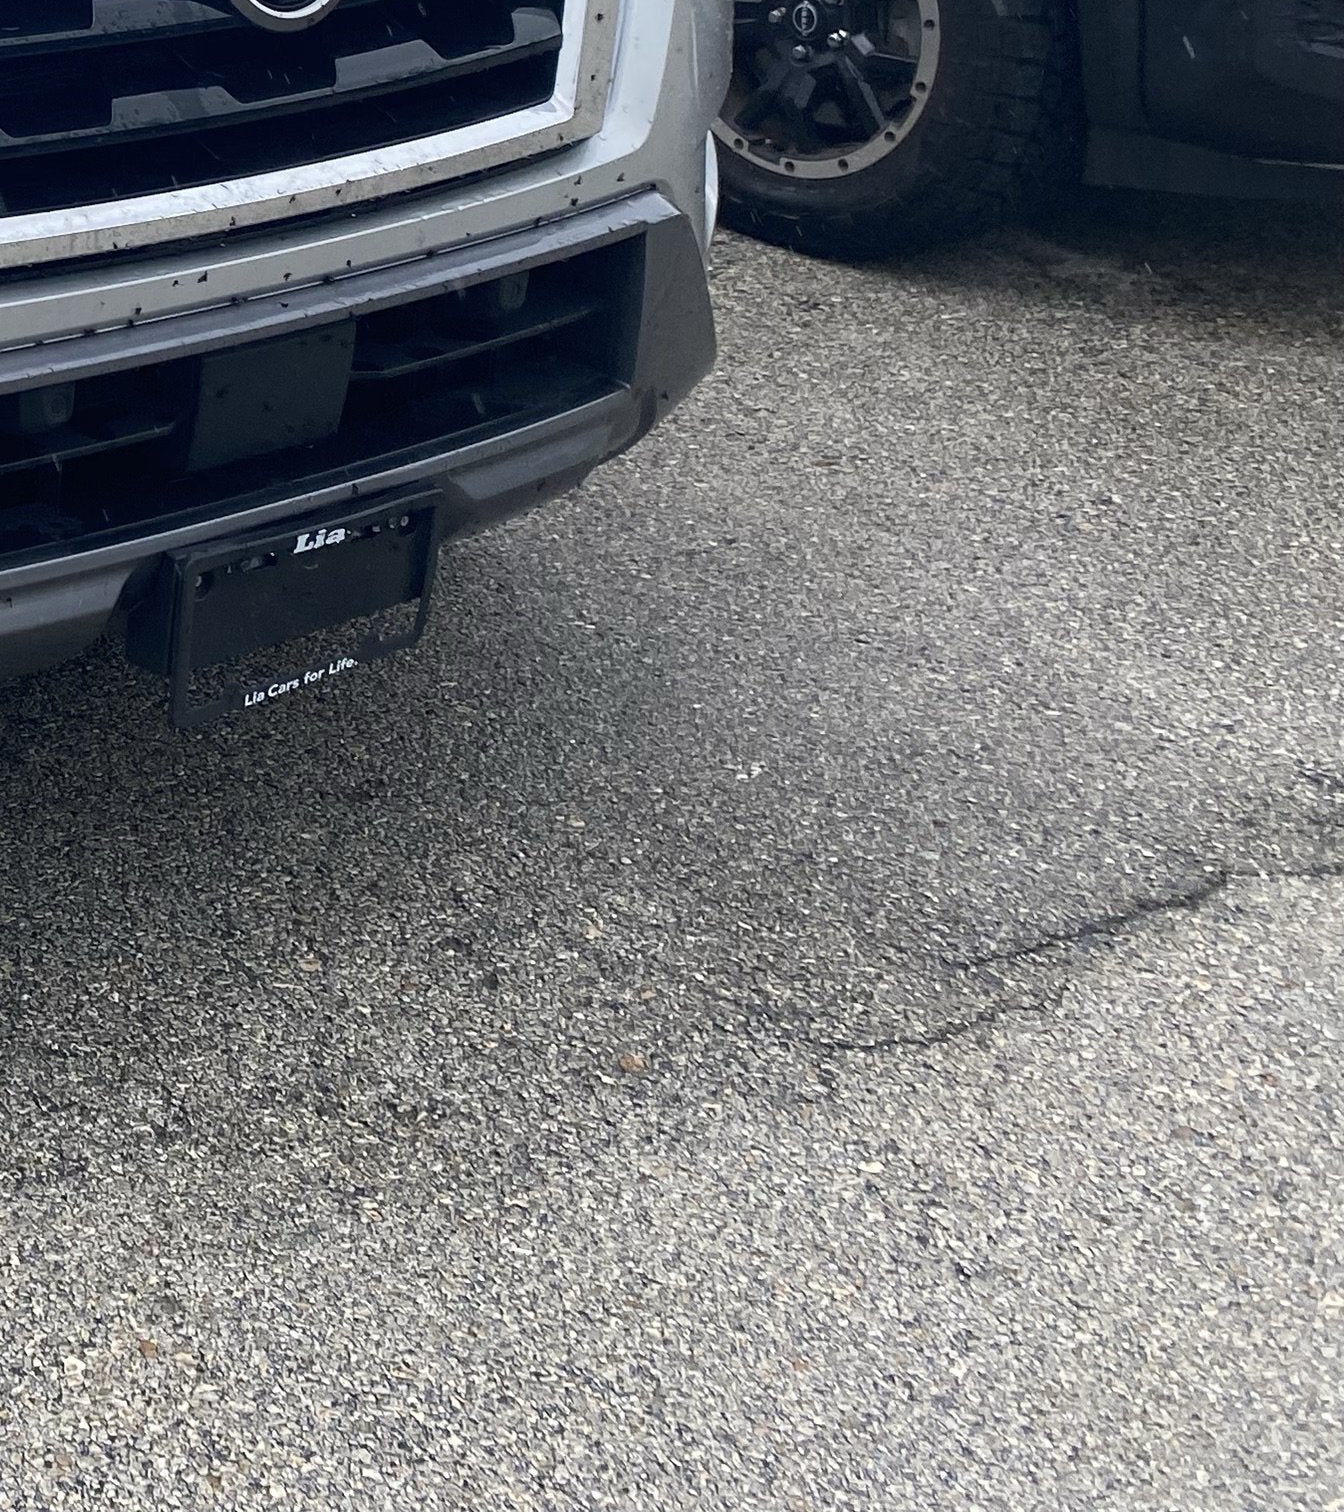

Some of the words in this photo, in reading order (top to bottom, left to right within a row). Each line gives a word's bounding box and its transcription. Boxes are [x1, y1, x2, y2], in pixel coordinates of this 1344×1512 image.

[293, 528, 346, 554] Lia
[244, 691, 265, 707] Lia
[267, 678, 300, 697] Cars
[303, 668, 325, 685] for
[328, 657, 359, 675] Life.
